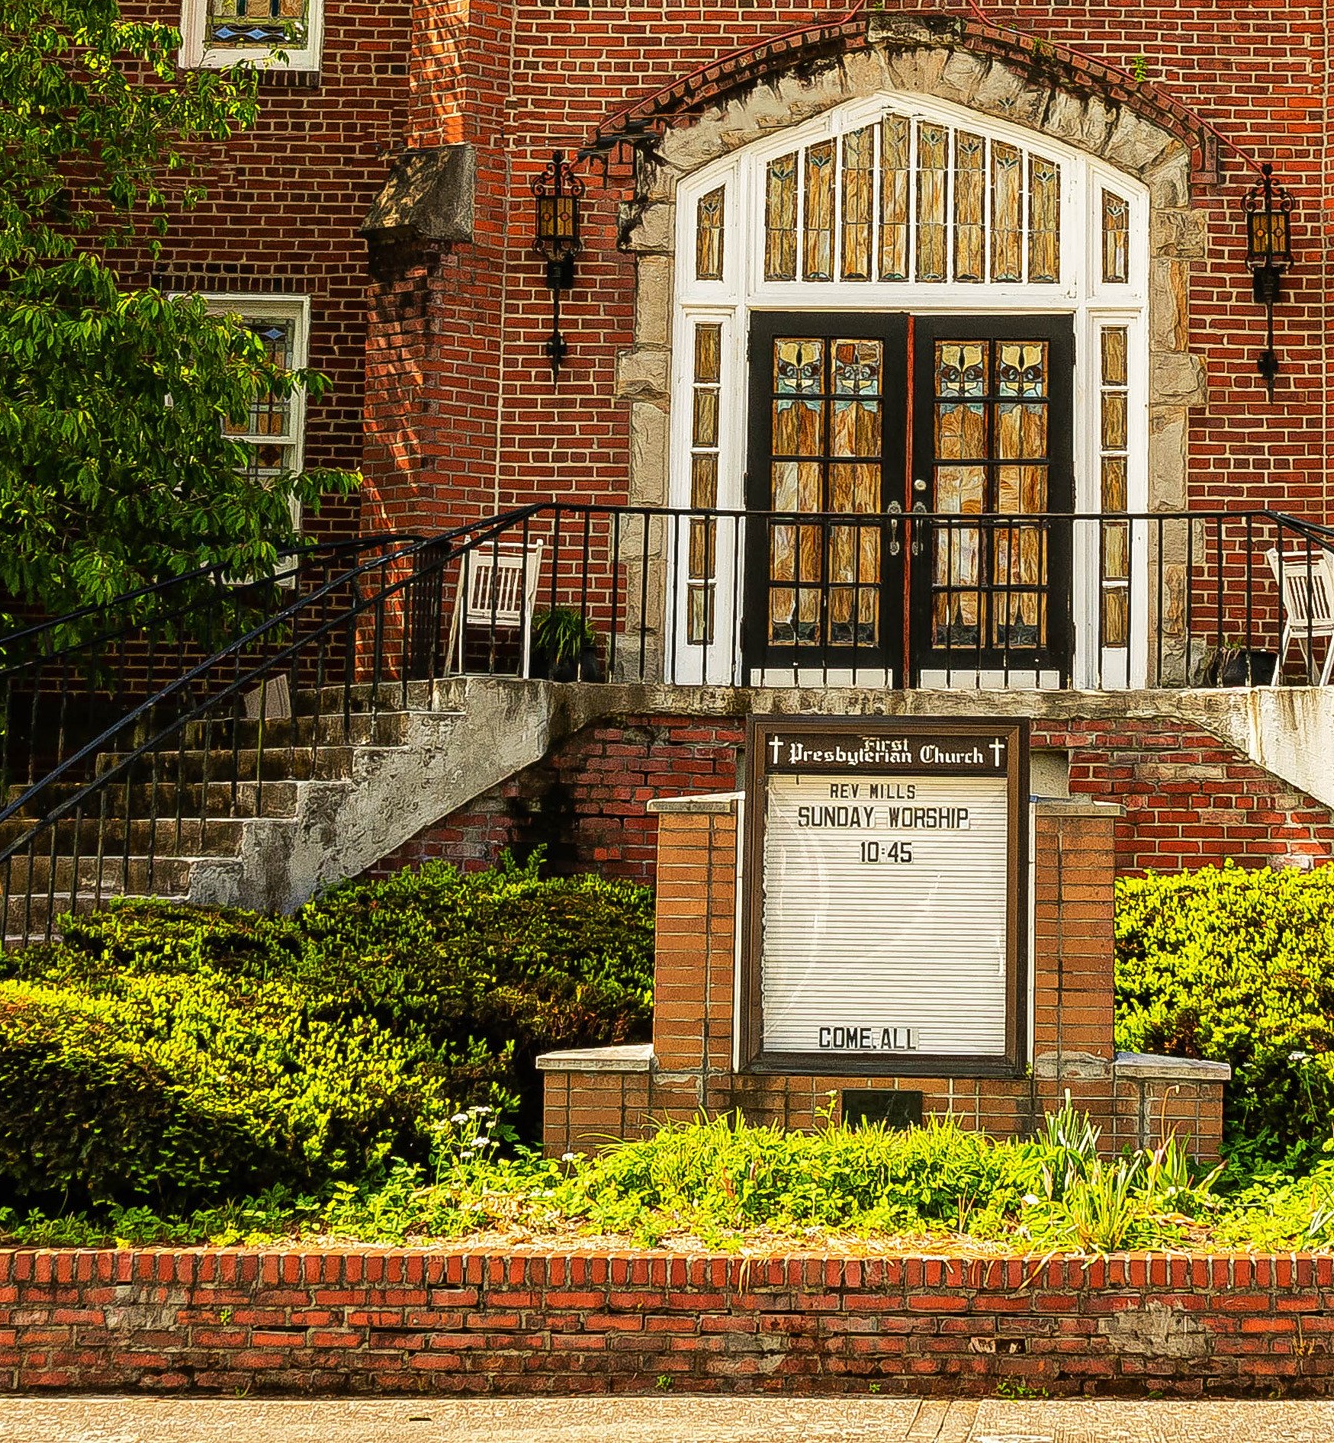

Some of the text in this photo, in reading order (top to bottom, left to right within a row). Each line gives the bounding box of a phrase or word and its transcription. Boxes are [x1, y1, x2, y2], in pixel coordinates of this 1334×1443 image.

[789, 743, 984, 766] Presbyterian Church
[863, 737, 909, 752] First
[830, 783, 916, 799] REV MILLS
[798, 806, 969, 829] SUNDAY WORSHIP
[860, 841, 913, 863] 10:45
